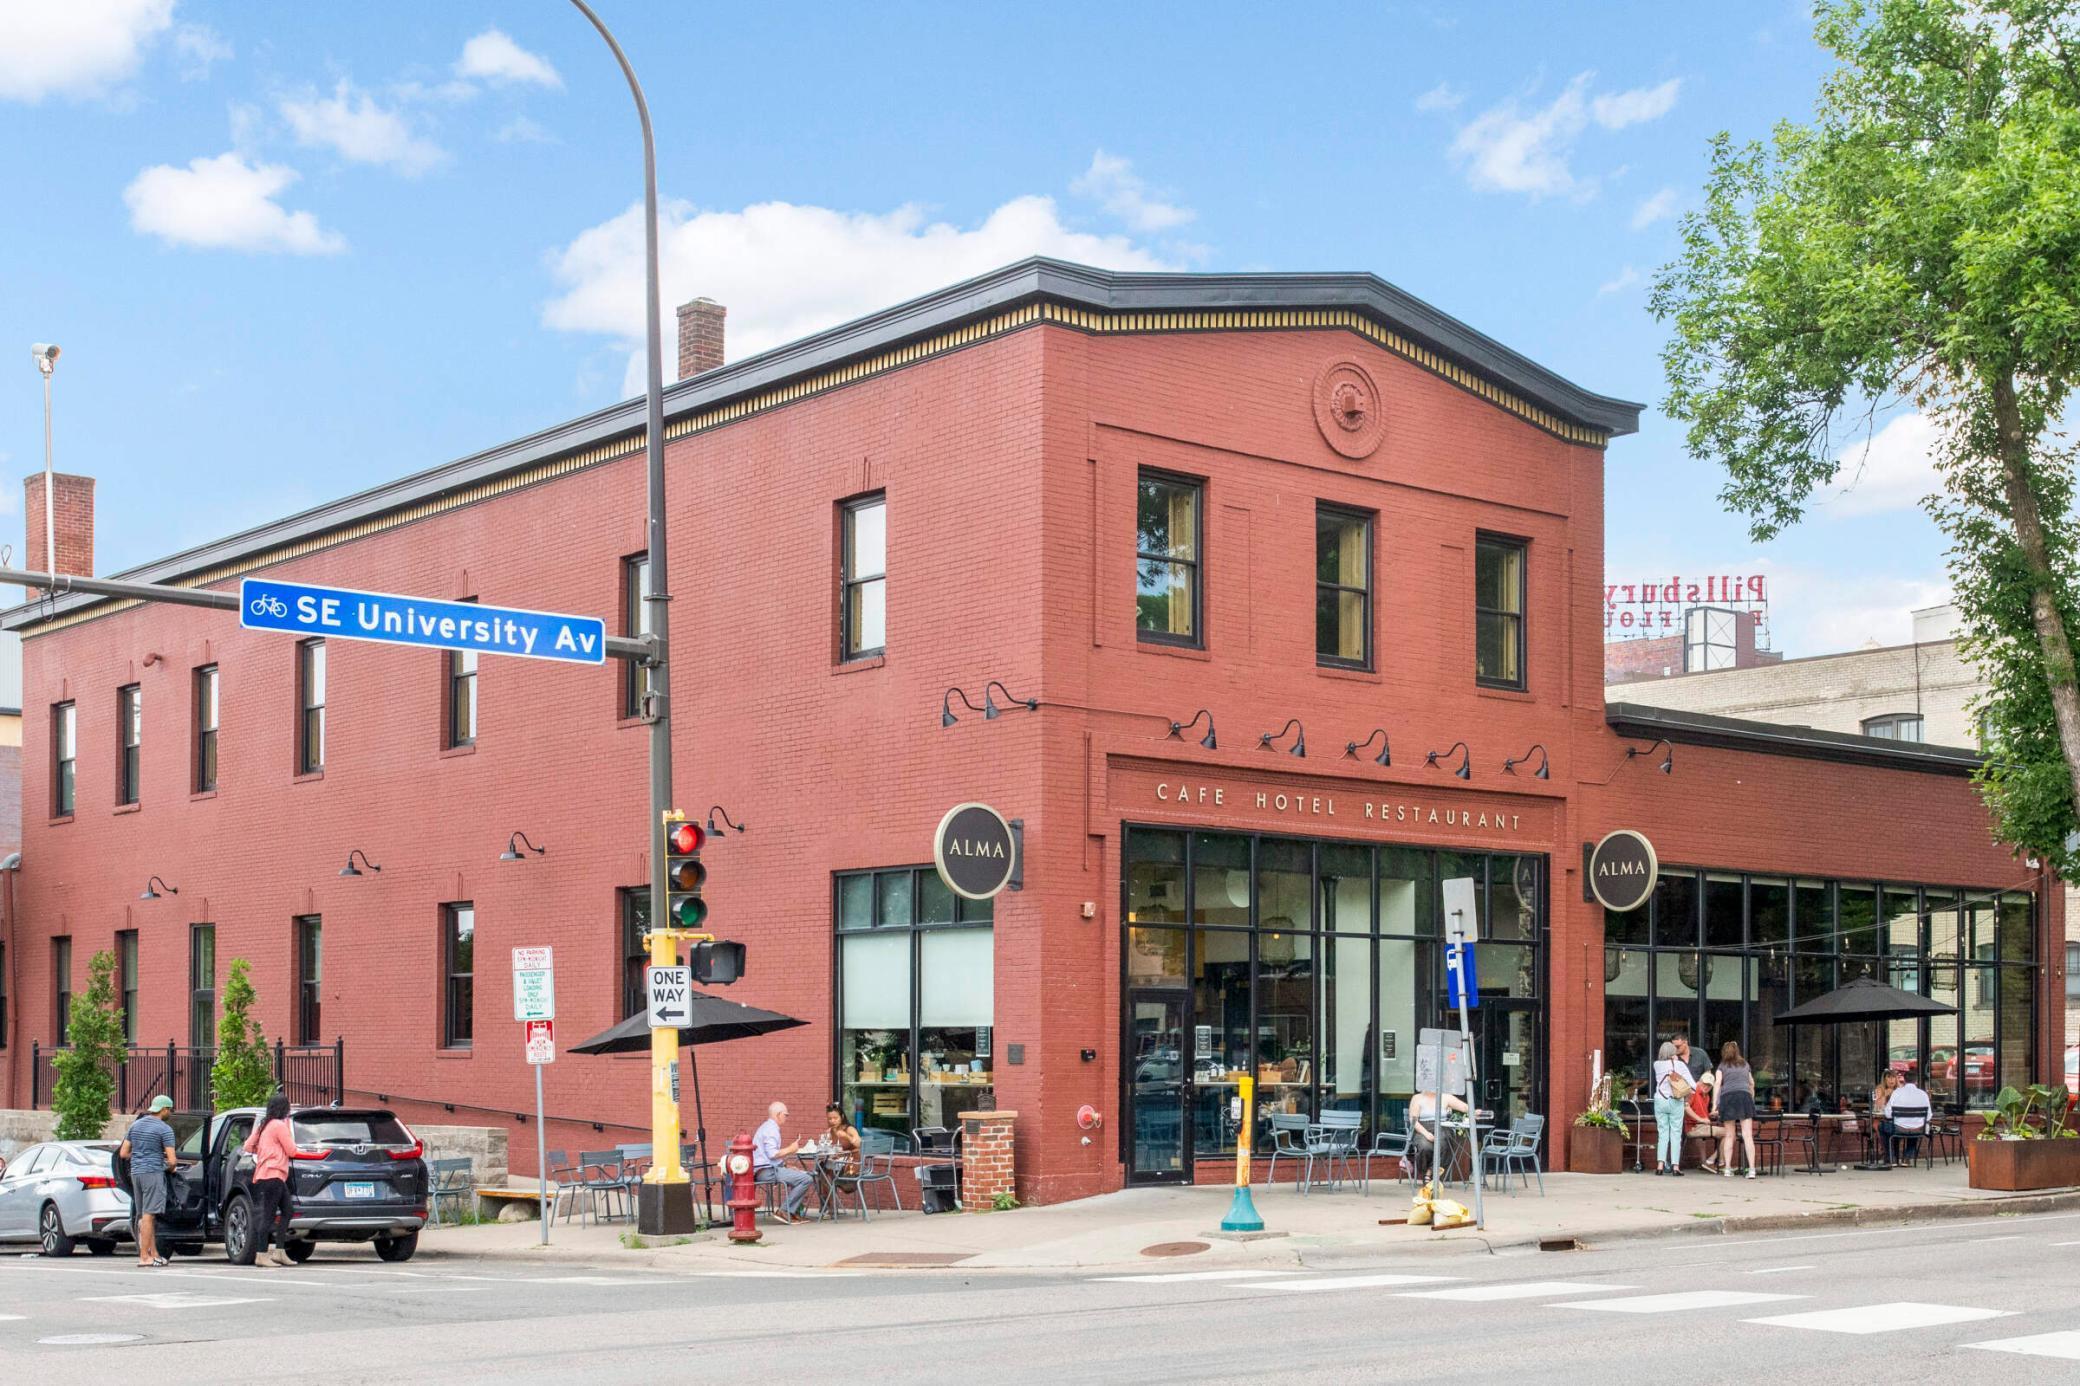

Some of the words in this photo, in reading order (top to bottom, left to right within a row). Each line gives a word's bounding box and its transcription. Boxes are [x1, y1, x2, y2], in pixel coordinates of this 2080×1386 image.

[297, 595, 341, 627] SE
[358, 602, 538, 654] University
[554, 625, 597, 653] Av
[1157, 783, 1224, 805] CAFE
[1256, 792, 1335, 816] HOTEL
[1365, 802, 1520, 831] RESTAURANT
[949, 838, 1005, 859] ALMA
[1598, 860, 1645, 877] ALMA
[654, 971, 685, 985] ONE
[653, 988, 685, 1002] WAY
